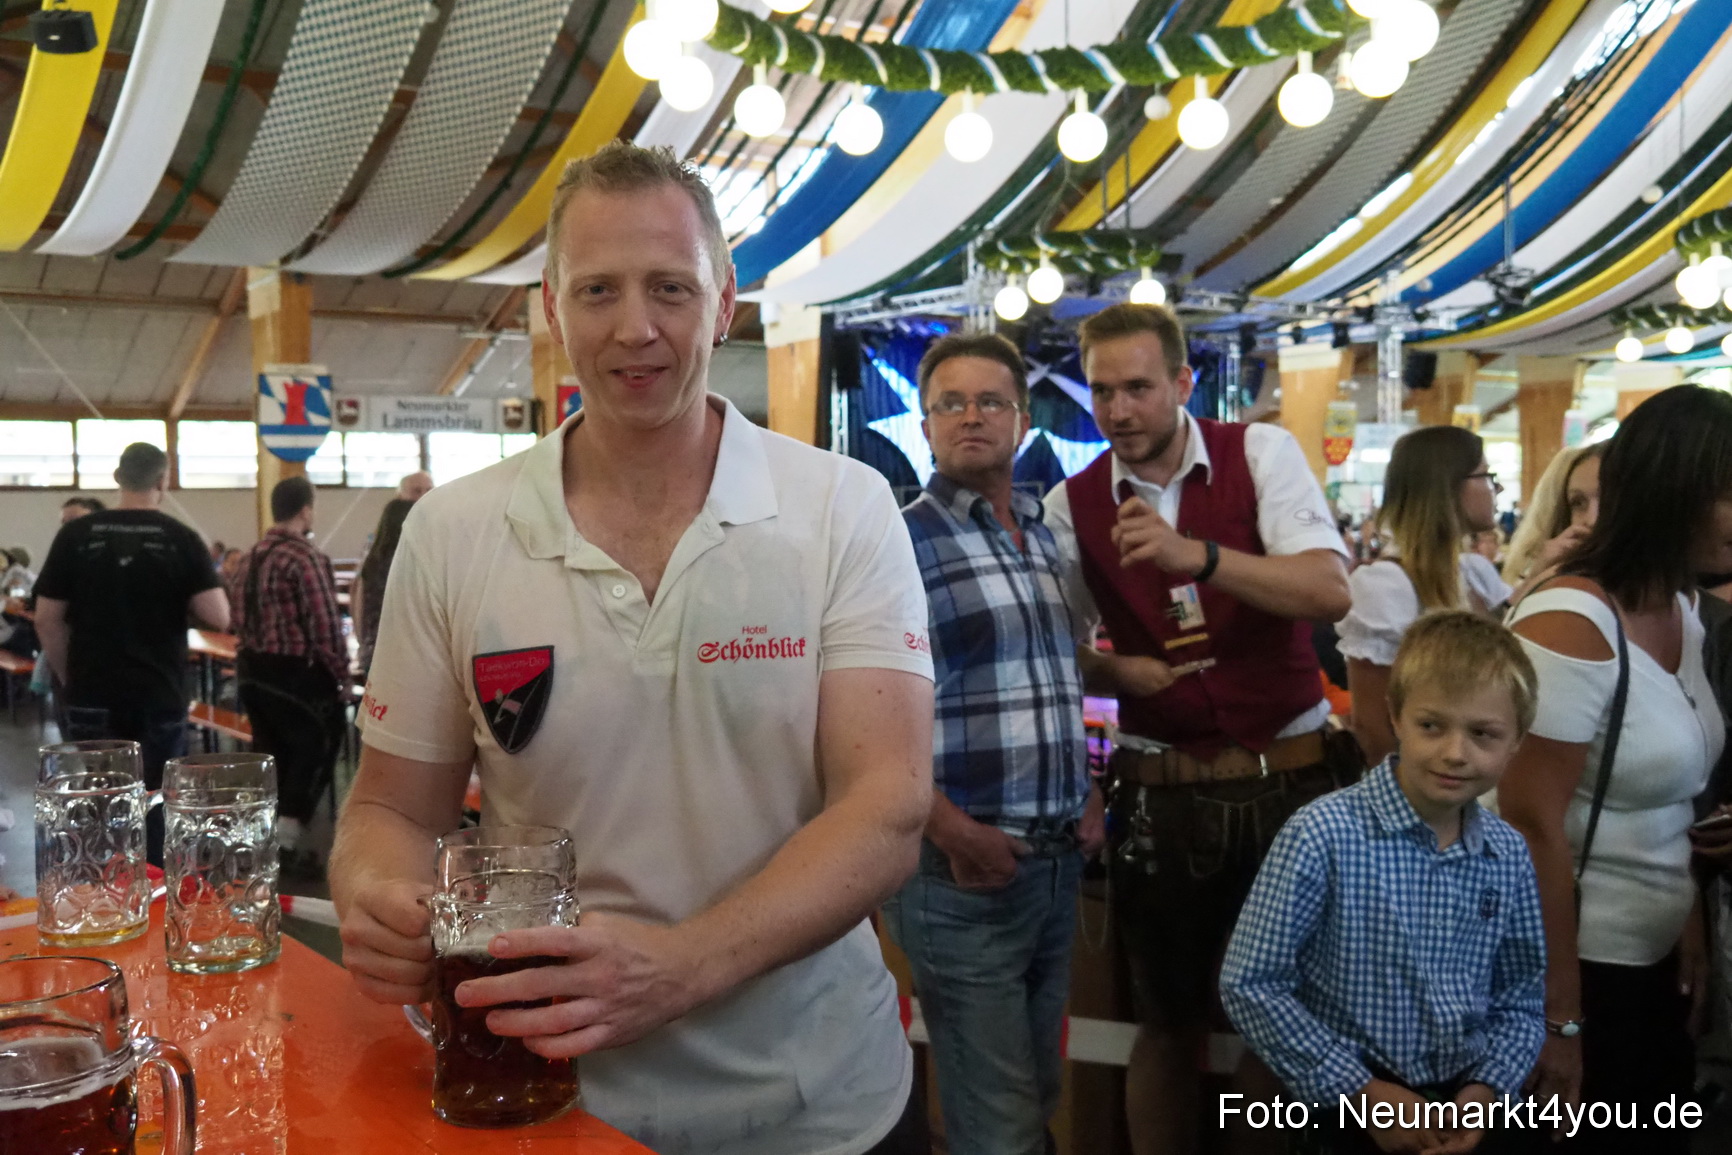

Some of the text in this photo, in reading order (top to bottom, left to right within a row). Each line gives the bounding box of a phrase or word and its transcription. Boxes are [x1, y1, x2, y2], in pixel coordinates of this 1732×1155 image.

[382, 412, 483, 430] Lammsbräu
[741, 624, 768, 635] Hotel
[697, 637, 807, 664] Schönblick
